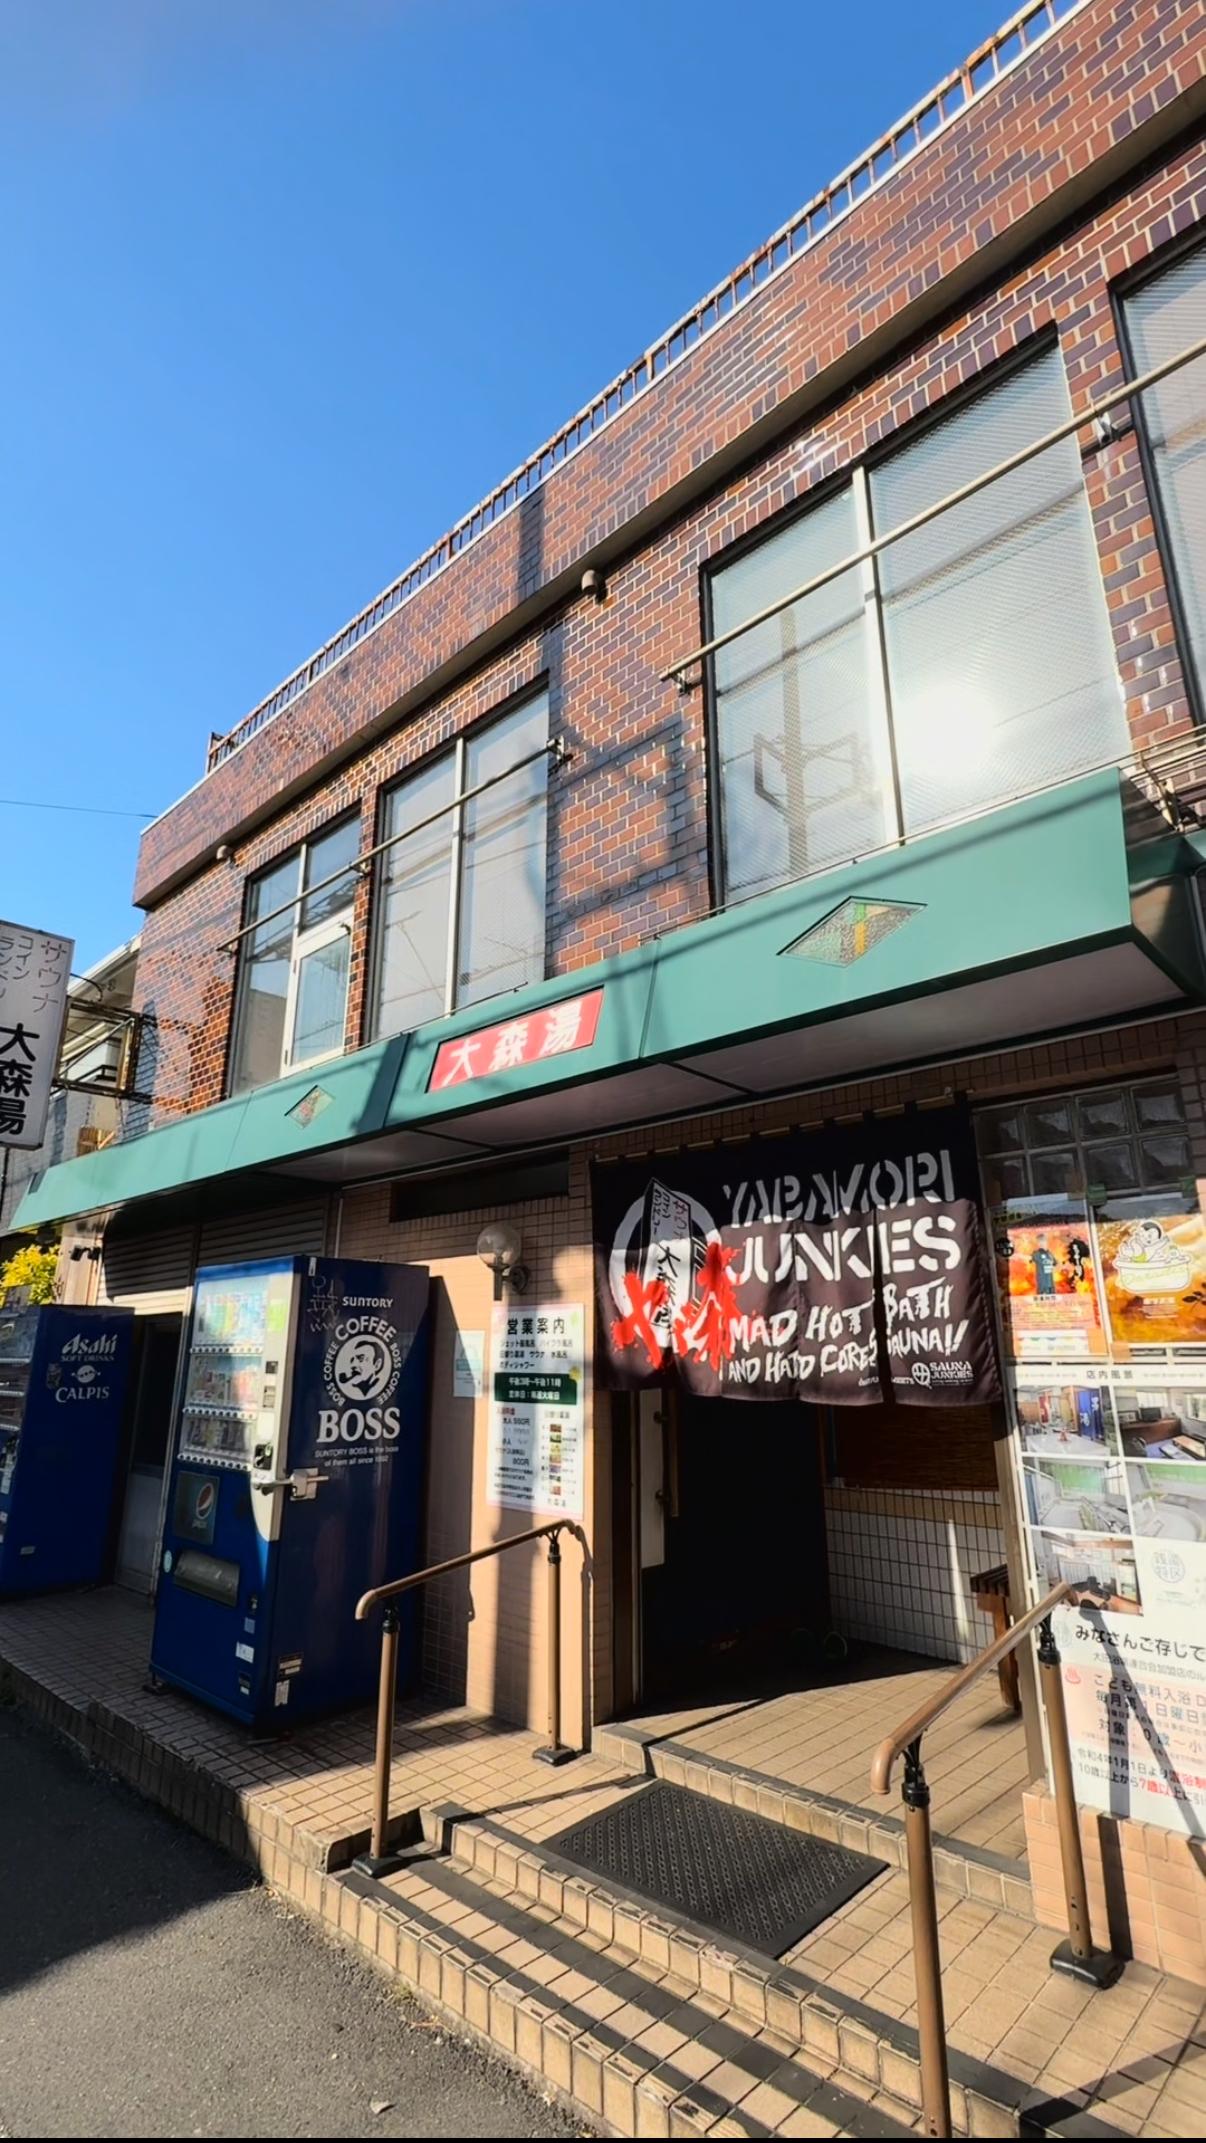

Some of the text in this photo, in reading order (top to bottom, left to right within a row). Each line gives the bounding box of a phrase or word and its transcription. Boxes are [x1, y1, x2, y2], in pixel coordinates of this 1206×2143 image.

[13, 935, 34, 980] コイン
[33, 941, 67, 1013] サウナ
[442, 998, 583, 1087] 大森湯
[725, 1215, 961, 1287] JUNKIES
[342, 1296, 394, 1308] SUNTORY
[729, 1309, 798, 1354] MAD
[805, 1289, 875, 1342] HOT
[882, 1276, 955, 1331] BATH
[335, 1315, 398, 1342] COFFEE
[507, 1317, 565, 1335] 営業案内
[61, 1354, 82, 1362] SOFT
[62, 1333, 118, 1354] Asahi
[323, 1341, 338, 1382] COFFEE
[379, 1342, 402, 1405] BOSS COFFEE
[728, 1357, 761, 1384] AND
[820, 1343, 871, 1378] CORE
[929, 1361, 973, 1372] SAUNA
[55, 1386, 110, 1403] CALPIS
[325, 1382, 346, 1407] BOSS
[316, 1407, 401, 1443] BOSS
[315, 1449, 347, 1458] SUNTORY
[349, 1446, 367, 1455] BOSS
